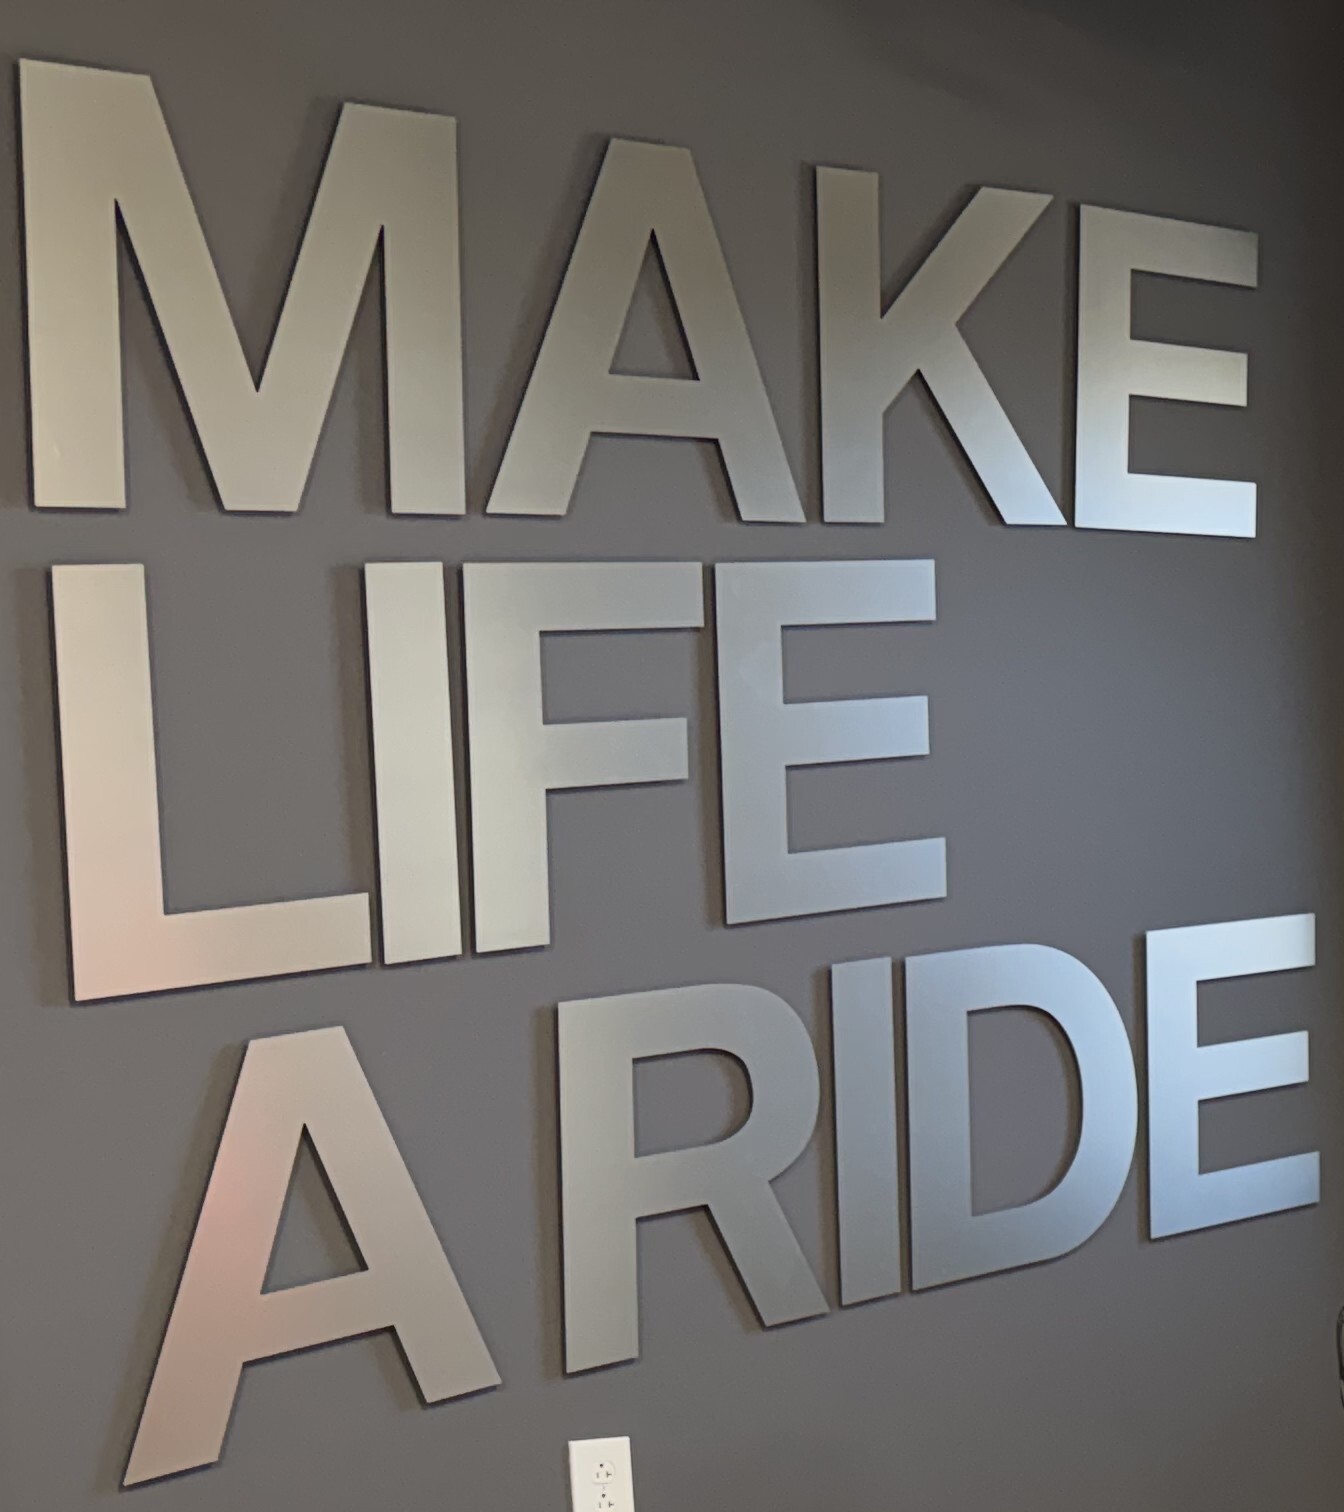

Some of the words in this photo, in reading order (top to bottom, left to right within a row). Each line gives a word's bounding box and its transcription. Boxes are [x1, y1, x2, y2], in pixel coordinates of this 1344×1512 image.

[19, 58, 1258, 538] MAKE
[50, 559, 947, 1002] LIFE
[123, 1026, 502, 1487] A
[557, 913, 1320, 1374] RIDE
